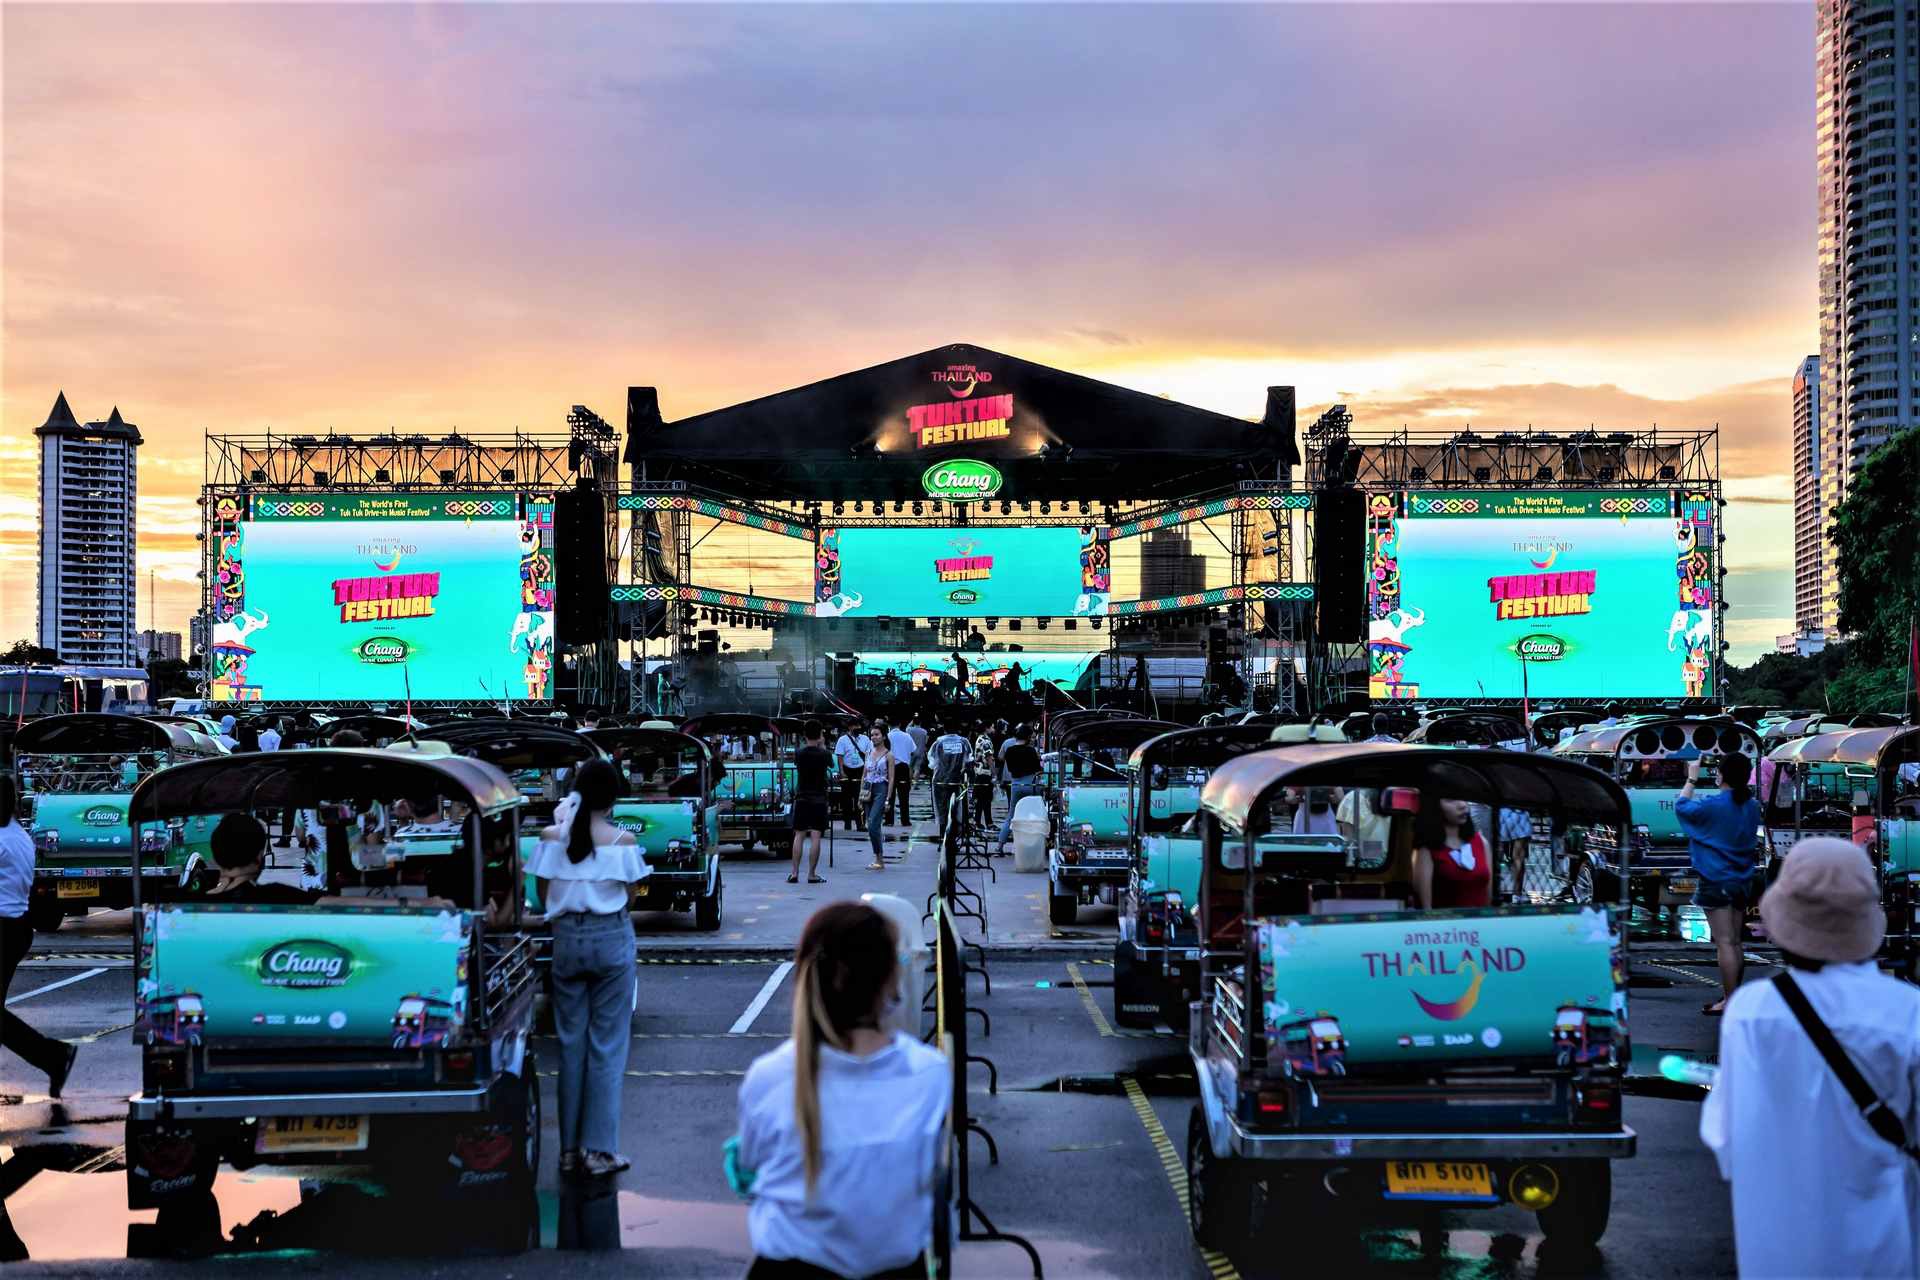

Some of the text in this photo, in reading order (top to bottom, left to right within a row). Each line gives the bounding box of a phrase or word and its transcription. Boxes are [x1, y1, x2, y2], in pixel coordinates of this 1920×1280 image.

[947, 364, 976, 373] amazing
[931, 371, 993, 382] THAILAND
[921, 417, 1011, 446] FESTIVAL
[934, 469, 991, 491] Chang
[359, 499, 409, 508] The World's First
[1513, 496, 1525, 506] The
[1526, 496, 1548, 506] World's
[340, 508, 351, 517] Tuk
[352, 508, 364, 517] Tuk
[389, 508, 406, 517] Music
[407, 508, 431, 517] Festival
[1494, 505, 1506, 514] Tuk
[1507, 505, 1518, 514] Tuk
[1544, 505, 1561, 514] Music
[1562, 505, 1586, 514] Festival
[357, 544, 418, 555] THAILAND
[952, 592, 975, 601] Chang
[341, 596, 437, 624] FESTIVAL
[1496, 592, 1593, 622] FESTIVAL
[364, 642, 404, 658] Chang
[1521, 640, 1561, 655] Chang
[87, 809, 120, 822] Chang
[1404, 928, 1480, 947] amazing
[269, 950, 344, 977] Chang
[1361, 947, 1526, 977] THAILAND
[1435, 1164, 1485, 1182] 5101
